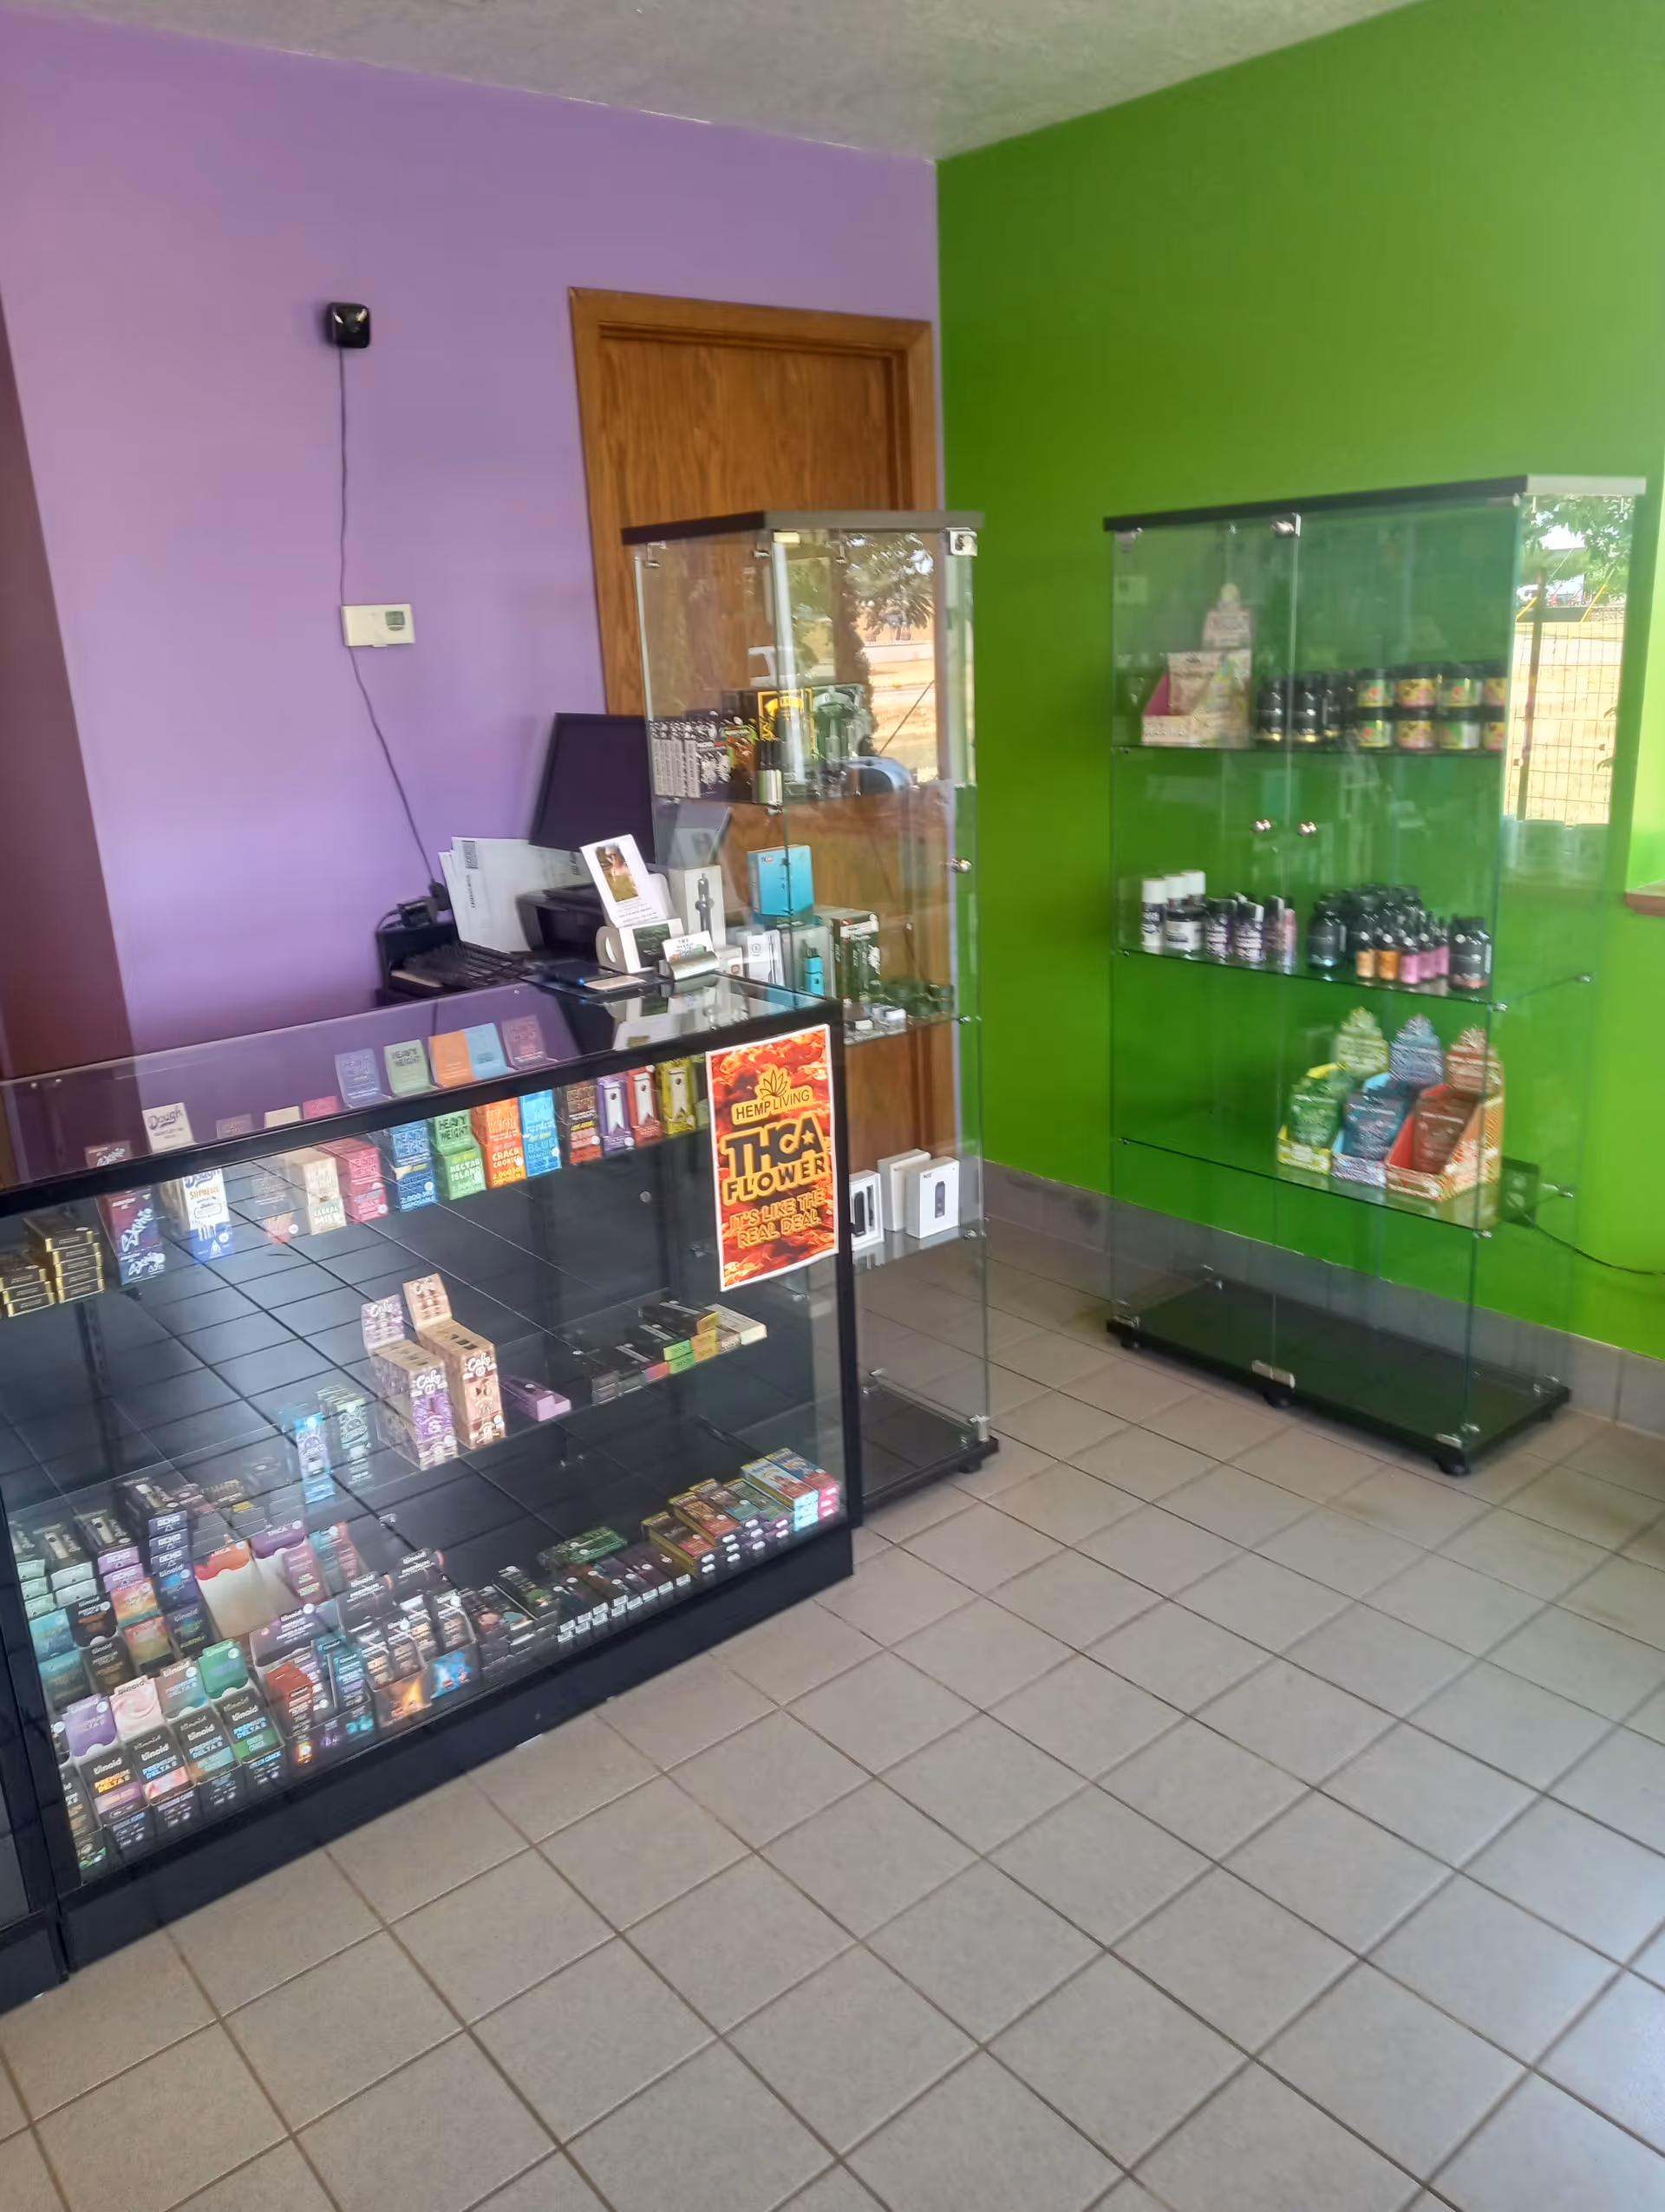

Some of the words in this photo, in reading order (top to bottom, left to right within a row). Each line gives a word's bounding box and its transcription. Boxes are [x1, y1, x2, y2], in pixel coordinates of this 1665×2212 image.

[735, 1100, 771, 1120] HEMP
[773, 1089, 810, 1110] LIVING
[725, 1117, 825, 1178] THCA
[727, 1154, 826, 1201] FLOWER
[729, 1209, 761, 1230] IT'S
[761, 1197, 797, 1223] LIKE
[796, 1187, 826, 1211] THE
[737, 1222, 780, 1249] REAL
[780, 1208, 821, 1236] DEAL
[415, 1370, 441, 1389] Cake
[467, 1352, 492, 1371] Cake
